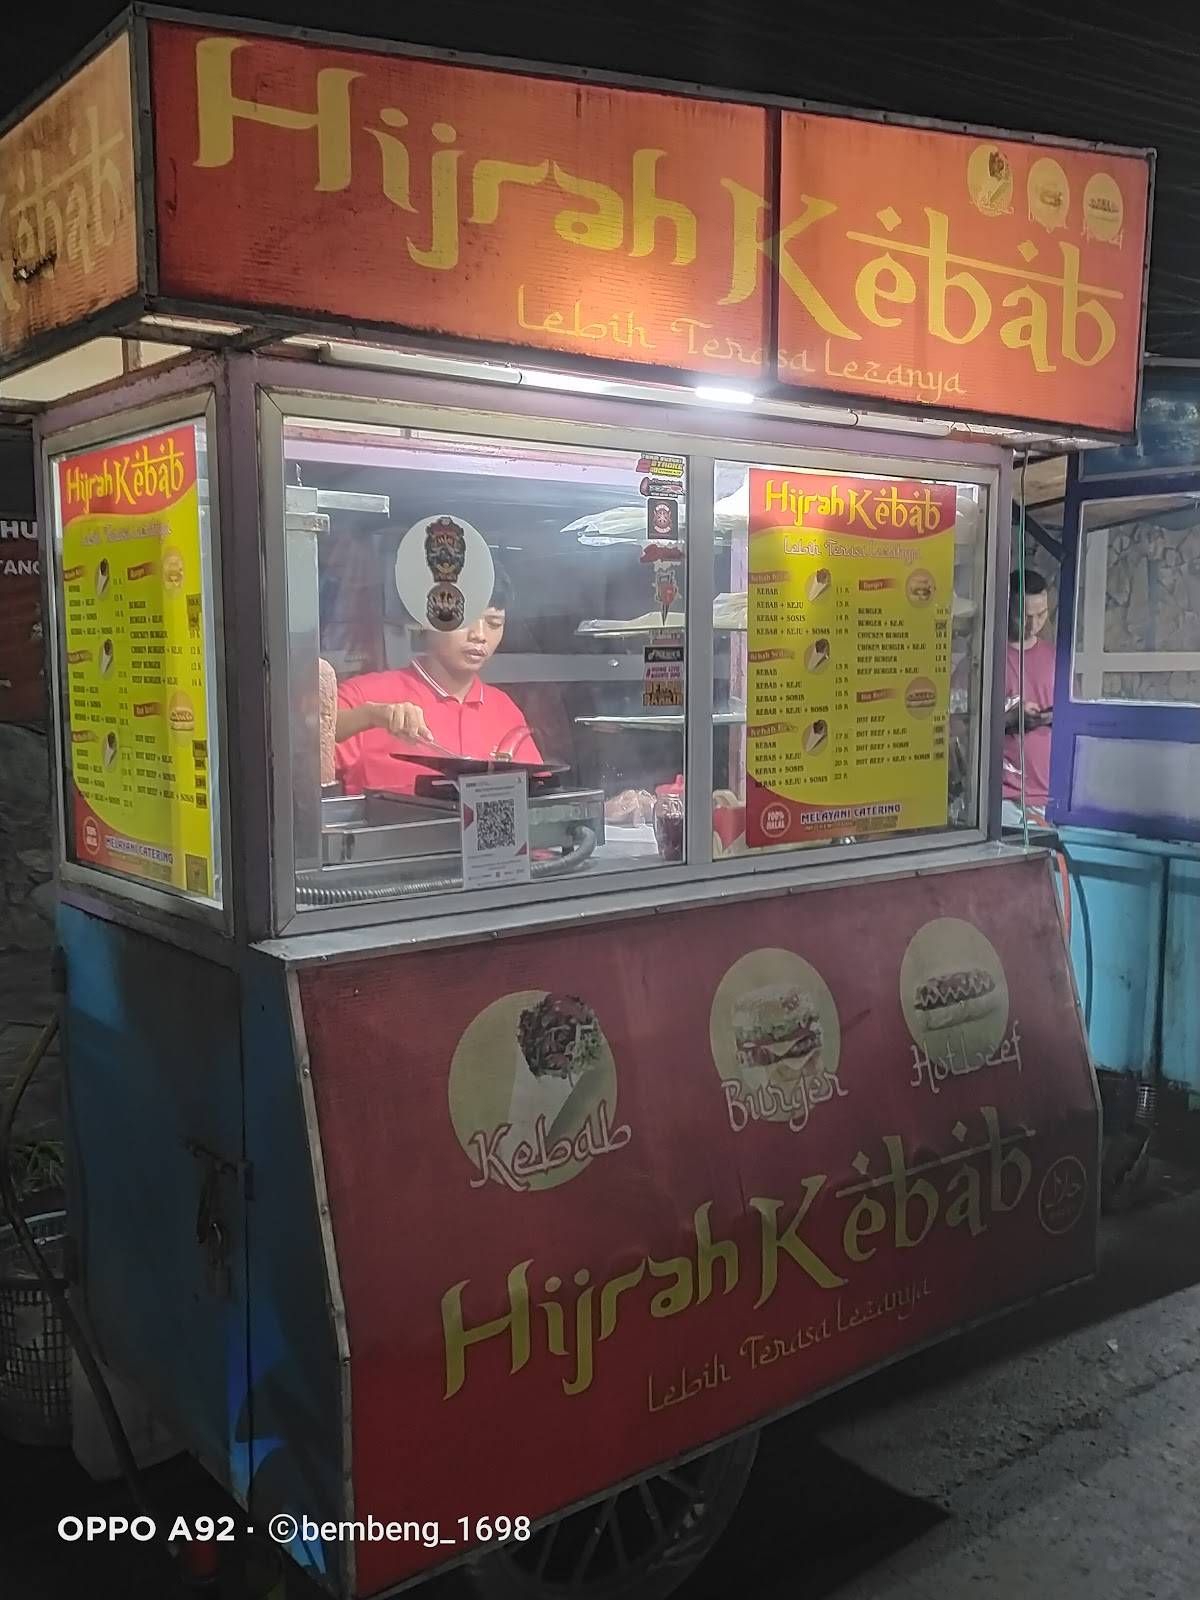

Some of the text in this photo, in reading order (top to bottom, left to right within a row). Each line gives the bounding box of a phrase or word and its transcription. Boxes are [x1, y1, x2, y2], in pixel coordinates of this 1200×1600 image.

[193, 37, 1124, 372] Hijrah Kebab
[518, 284, 656, 348] Lebih
[825, 339, 967, 404] Lezanya
[66, 438, 185, 513] Hijrah Kebab
[765, 479, 943, 533] Hijrah Kebab
[801, 804, 901, 823] MELAYANI CATERING
[469, 1100, 632, 1191] Kebab
[721, 1072, 848, 1132] Burger
[441, 1106, 1037, 1400] Hijrah Kebab
[649, 1354, 731, 1413] Lebih
[739, 1317, 831, 1369] Terasa
